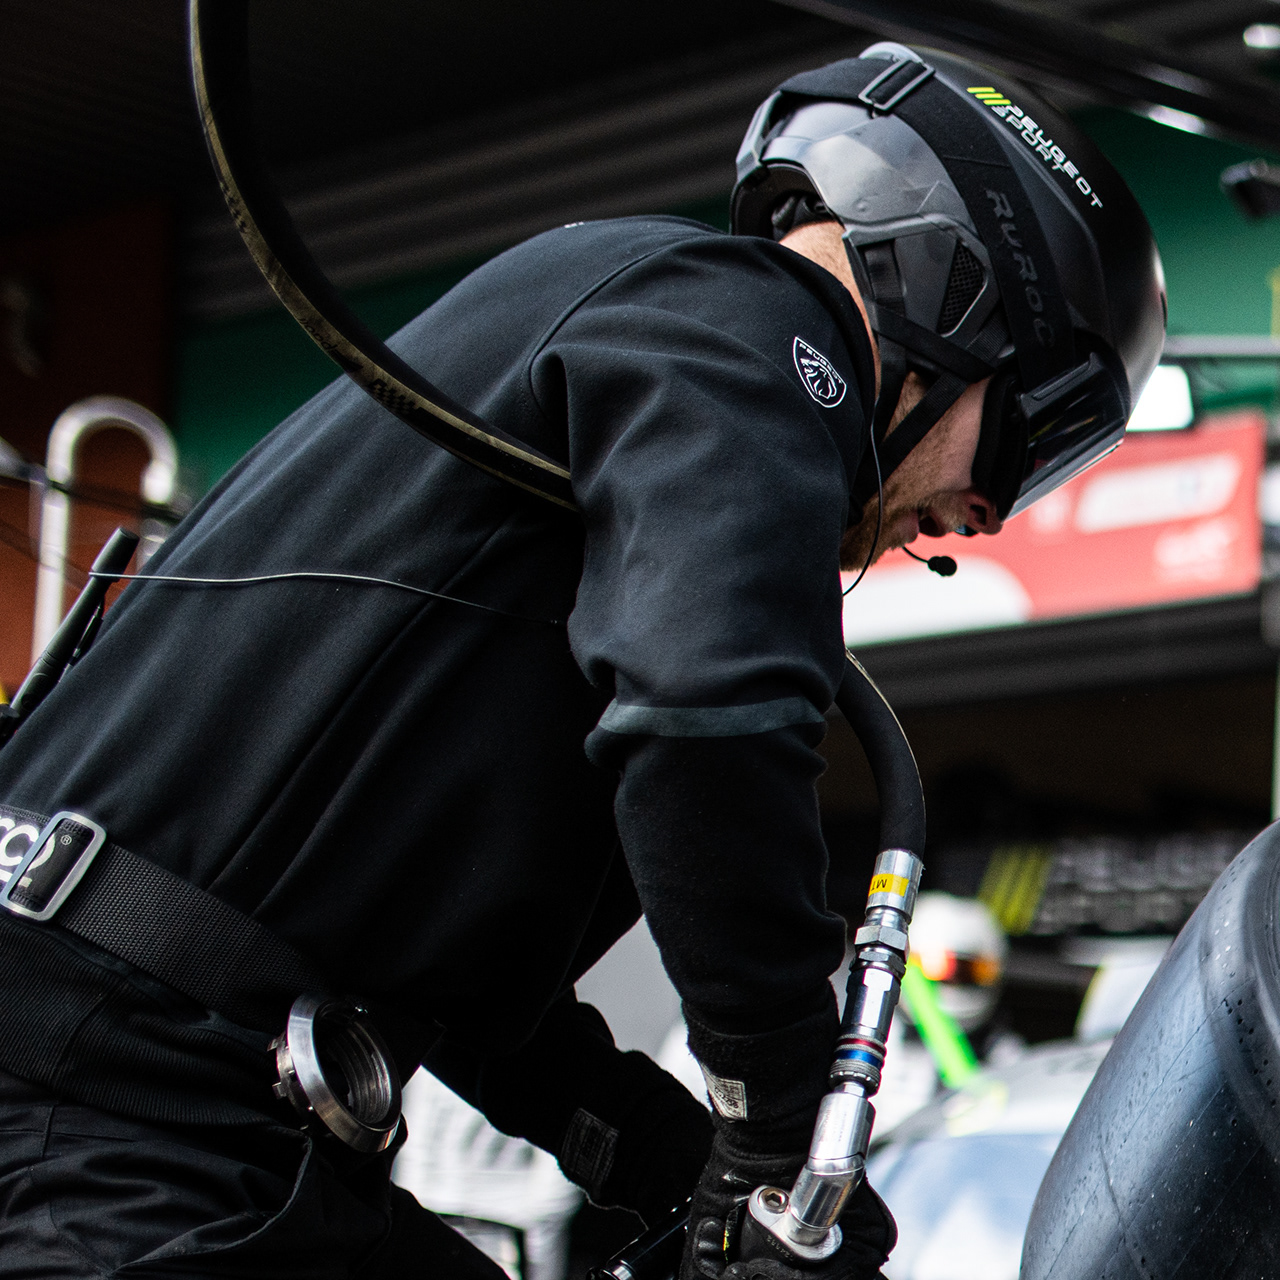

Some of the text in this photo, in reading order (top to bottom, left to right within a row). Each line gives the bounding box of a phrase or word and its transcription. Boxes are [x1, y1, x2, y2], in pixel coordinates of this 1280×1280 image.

[991, 105, 1065, 174] SPORT
[1004, 105, 1103, 208] PEUGEOT
[986, 189, 1055, 347] RUROC
